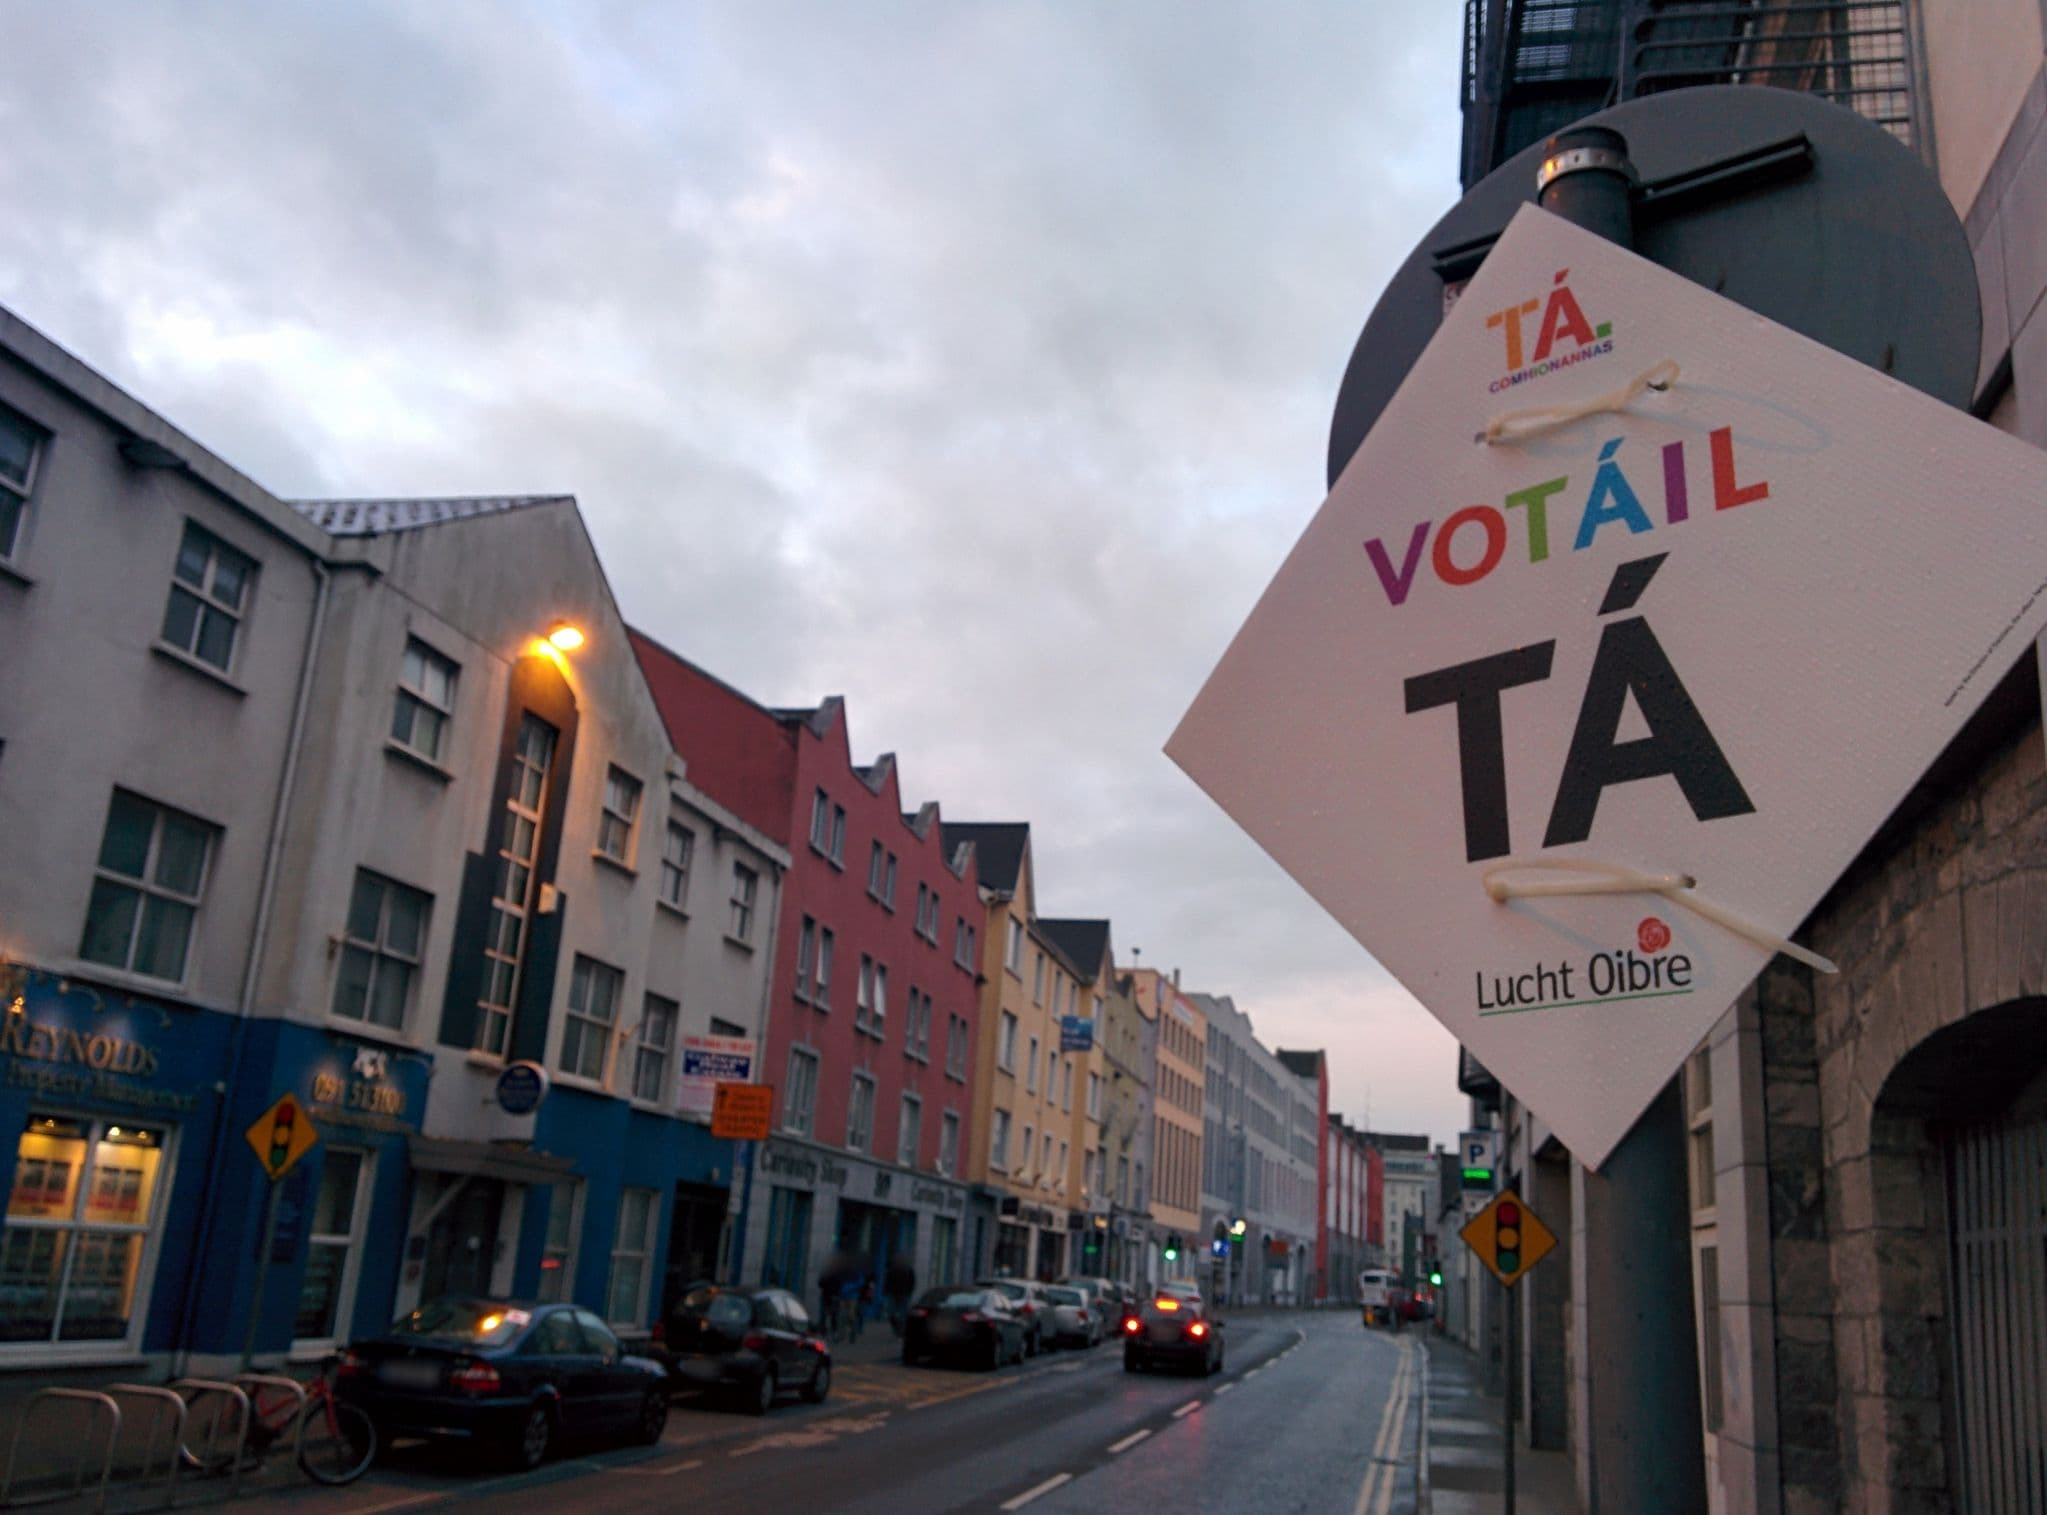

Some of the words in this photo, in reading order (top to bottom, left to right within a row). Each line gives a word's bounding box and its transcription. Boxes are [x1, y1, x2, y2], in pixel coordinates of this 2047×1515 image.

[1488, 340, 1614, 393] COMHIONANNAS
[1363, 425, 1769, 606] VOTÁIL
[1403, 551, 1756, 863] TÁ
[1477, 960, 1575, 1010] Lucht
[1589, 950, 1693, 997] Oibre
[1469, 1143, 1485, 1164] P
